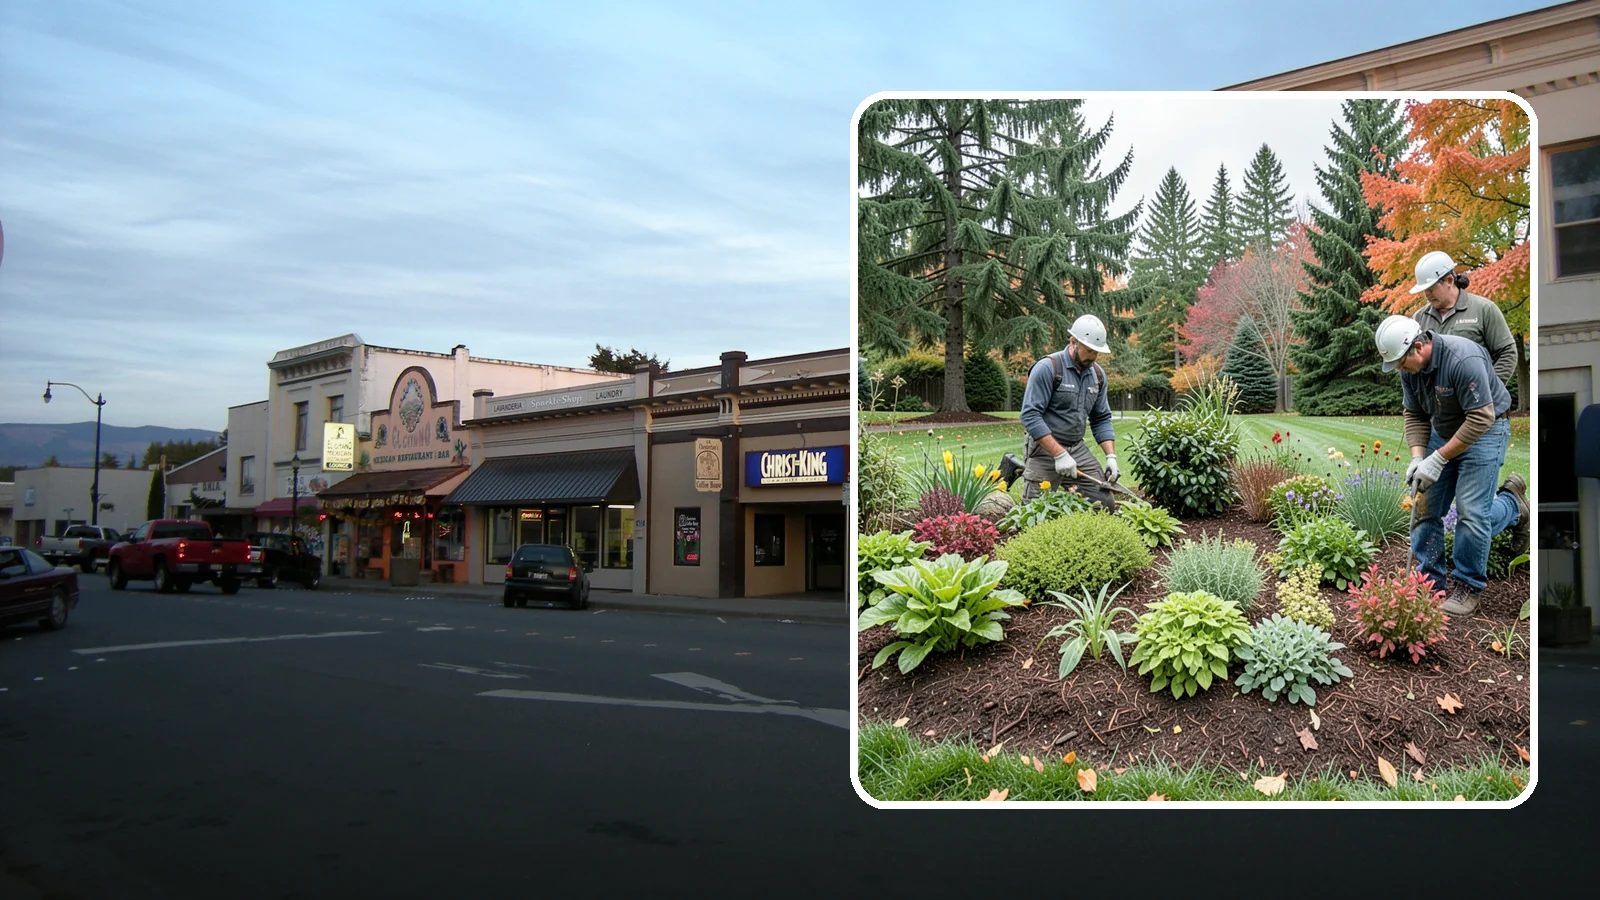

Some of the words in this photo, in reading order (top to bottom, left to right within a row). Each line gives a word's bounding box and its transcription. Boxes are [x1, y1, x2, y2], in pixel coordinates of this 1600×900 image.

[561, 394, 583, 406] Shop
[595, 389, 624, 400] LAUNDRY
[493, 402, 522, 412] LAVANDERIA
[373, 455, 396, 463] MEXICAN
[397, 451, 433, 461] RESTAURANT
[437, 450, 450, 459] BAR
[761, 452, 797, 478] CHRIST
[799, 450, 827, 476] KING
[710, 481, 722, 489] House
